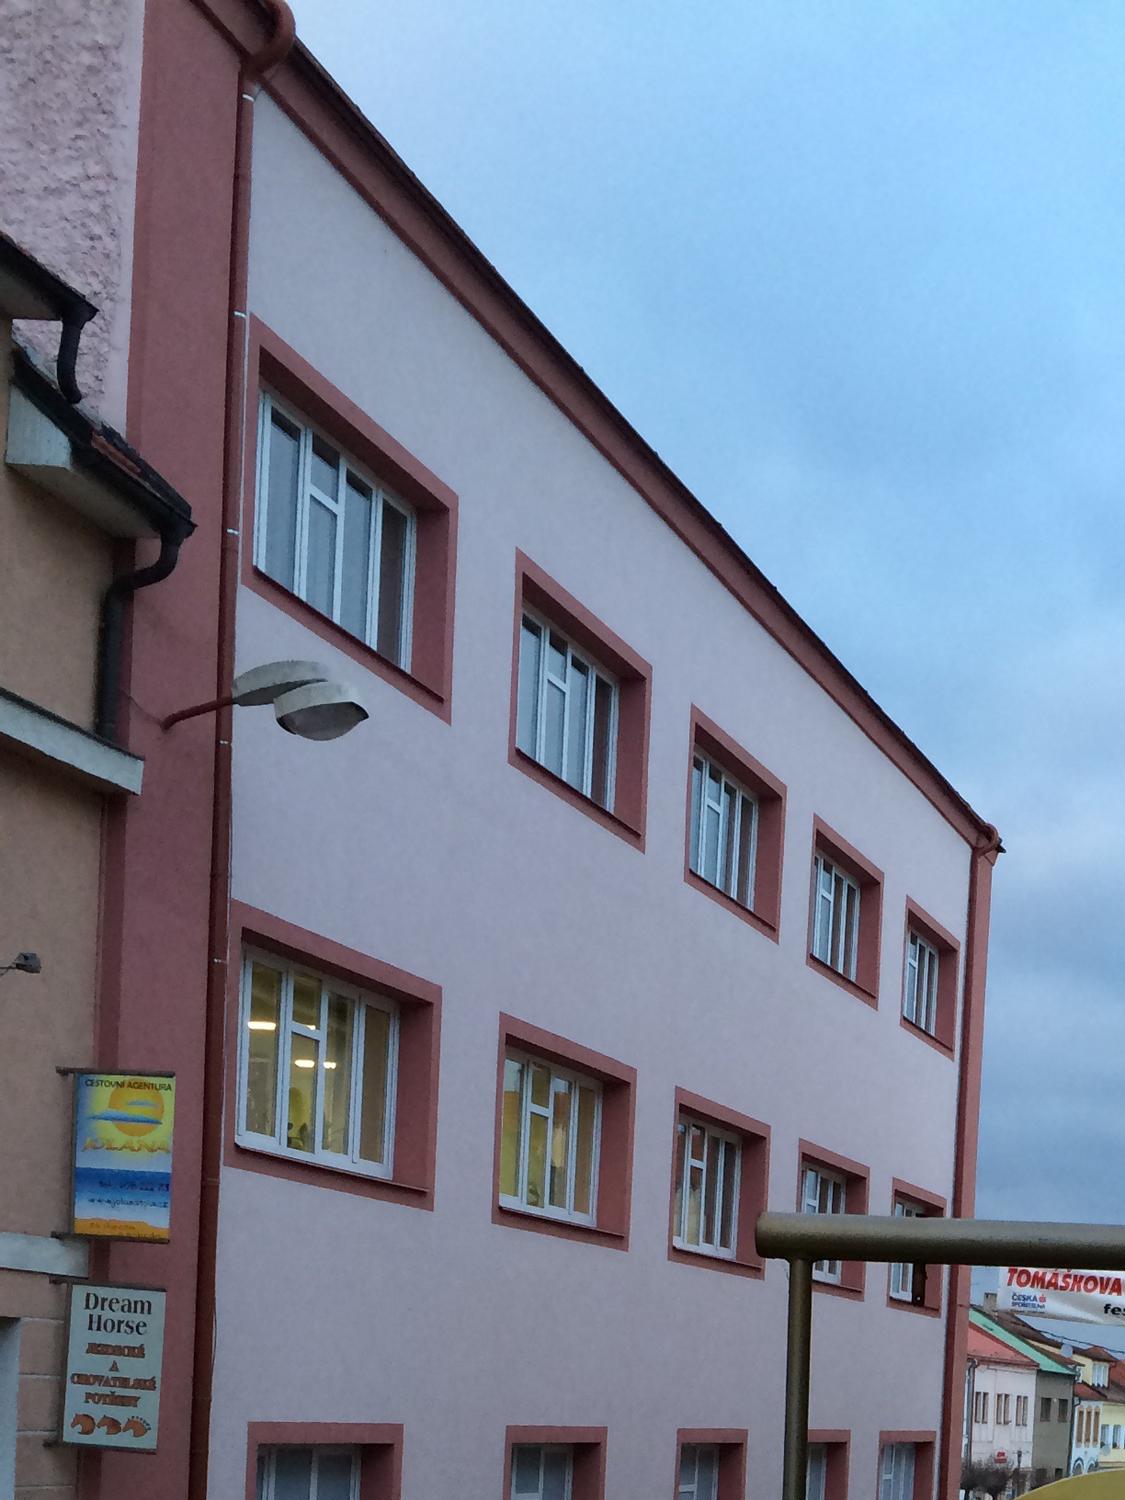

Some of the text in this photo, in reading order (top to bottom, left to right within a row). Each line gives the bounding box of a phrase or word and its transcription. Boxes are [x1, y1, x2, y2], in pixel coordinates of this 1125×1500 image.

[127, 1081, 172, 1091] AGENTURA
[1007, 1266, 1122, 1297] TOMÁŠKOVA
[84, 1292, 152, 1315] Dream
[87, 1313, 148, 1336] Horse
[109, 1360, 120, 1372] A
